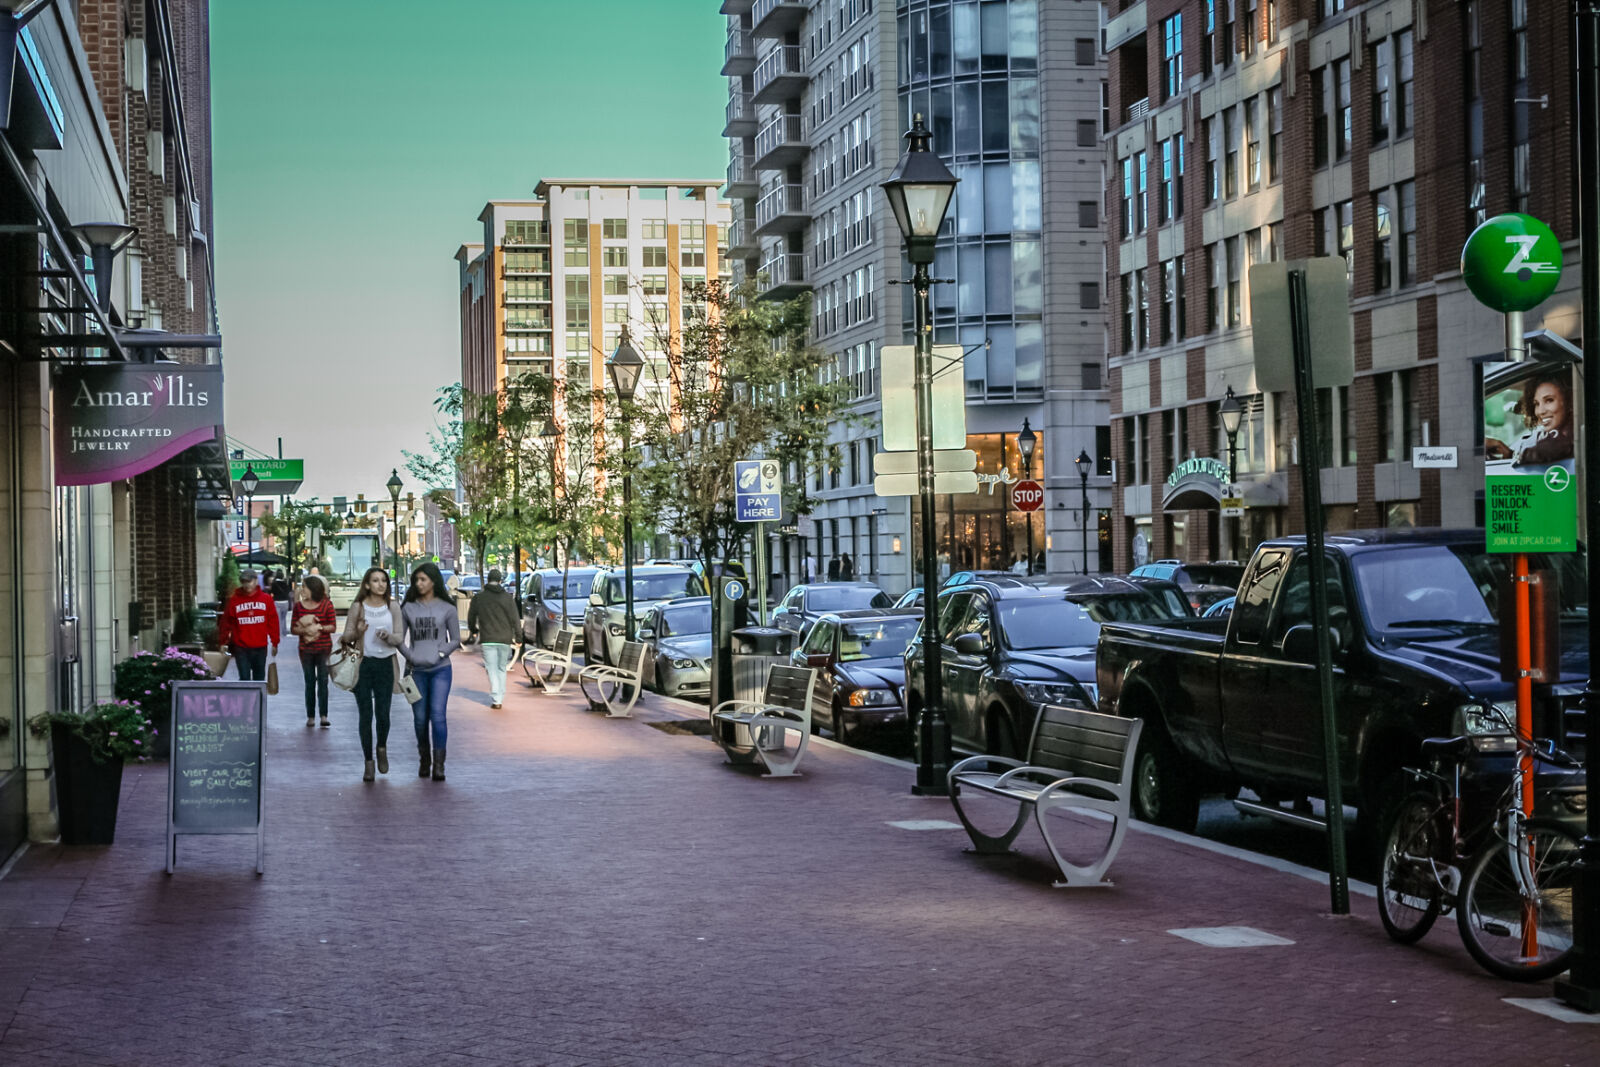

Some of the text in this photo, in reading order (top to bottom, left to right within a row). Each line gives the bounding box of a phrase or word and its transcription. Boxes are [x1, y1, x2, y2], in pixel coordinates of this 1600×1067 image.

[71, 426, 172, 437] HANDCRAFTED
[71, 440, 131, 453] JEWELRY
[765, 464, 773, 474] 2
[1491, 484, 1535, 496] RESERVE.
[747, 497, 769, 507] PAY
[1014, 490, 1042, 503] STOP
[1491, 497, 1531, 509] UNLOCK.
[743, 507, 775, 517] HERE
[1492, 510, 1522, 521] DRIVE.
[1492, 522, 1523, 534] SMILE.
[1493, 536, 1508, 545] JOIN
[1510, 536, 1517, 545] AT
[731, 584, 740, 597] P
[235, 601, 267, 613] MARYLAND
[238, 615, 265, 625] TERRAPINS
[415, 616, 437, 628] UNDER
[183, 692, 257, 722] NEW!
[184, 722, 227, 735] FOSSIL
[182, 768, 209, 777] VISIT
[212, 769, 230, 777] OUR
